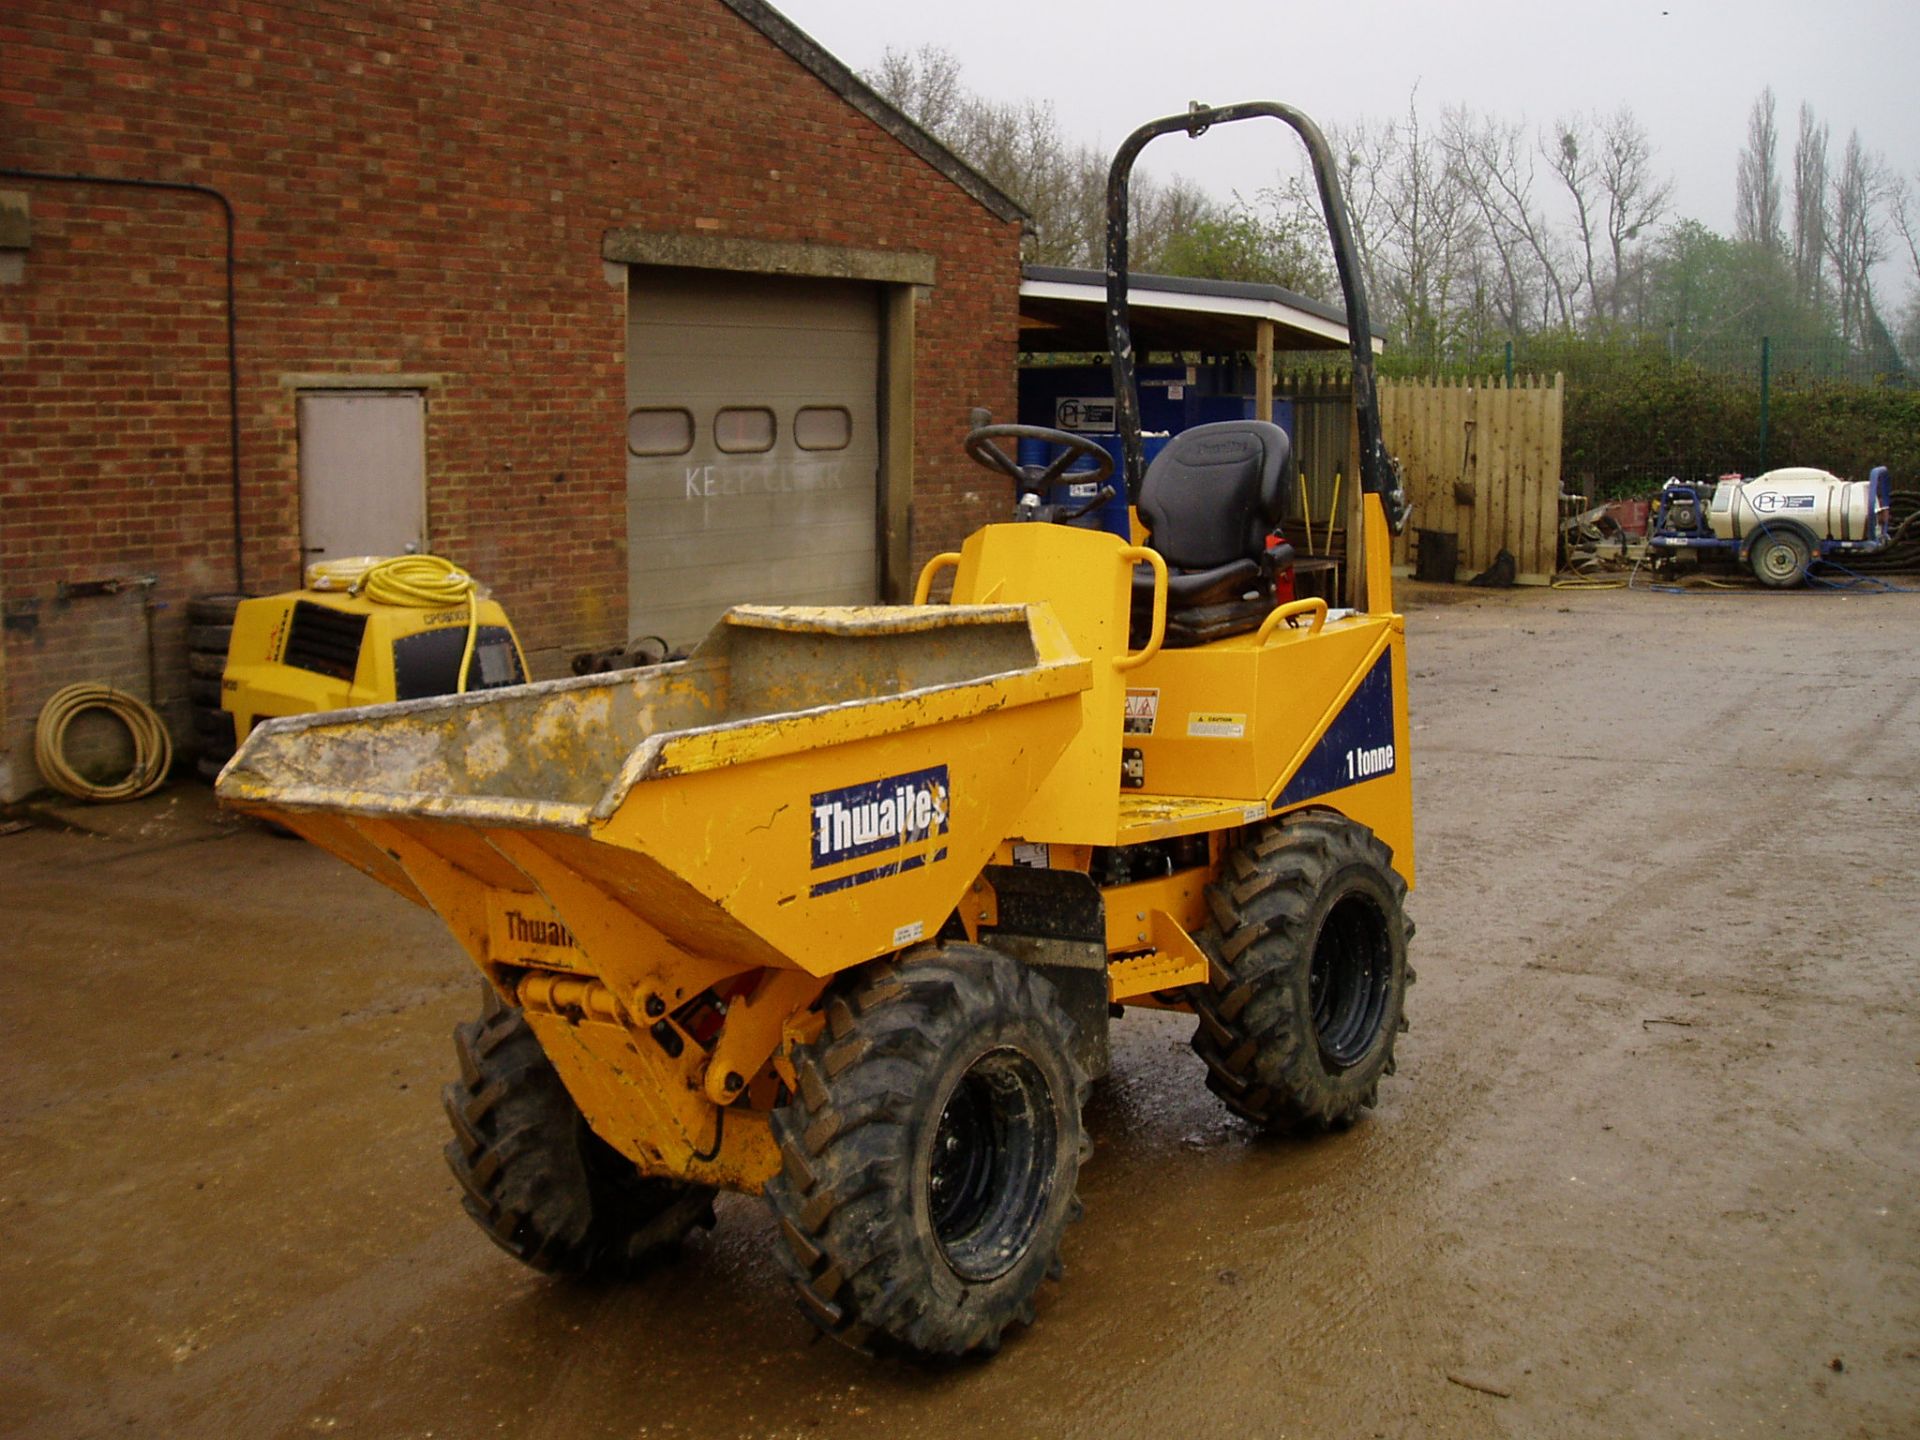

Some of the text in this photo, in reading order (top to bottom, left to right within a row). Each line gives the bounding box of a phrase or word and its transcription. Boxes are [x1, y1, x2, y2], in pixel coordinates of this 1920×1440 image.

[686, 464, 752, 497] KEEP
[1346, 744, 1394, 780] 1 tonne
[815, 784, 946, 855] Thwaites
